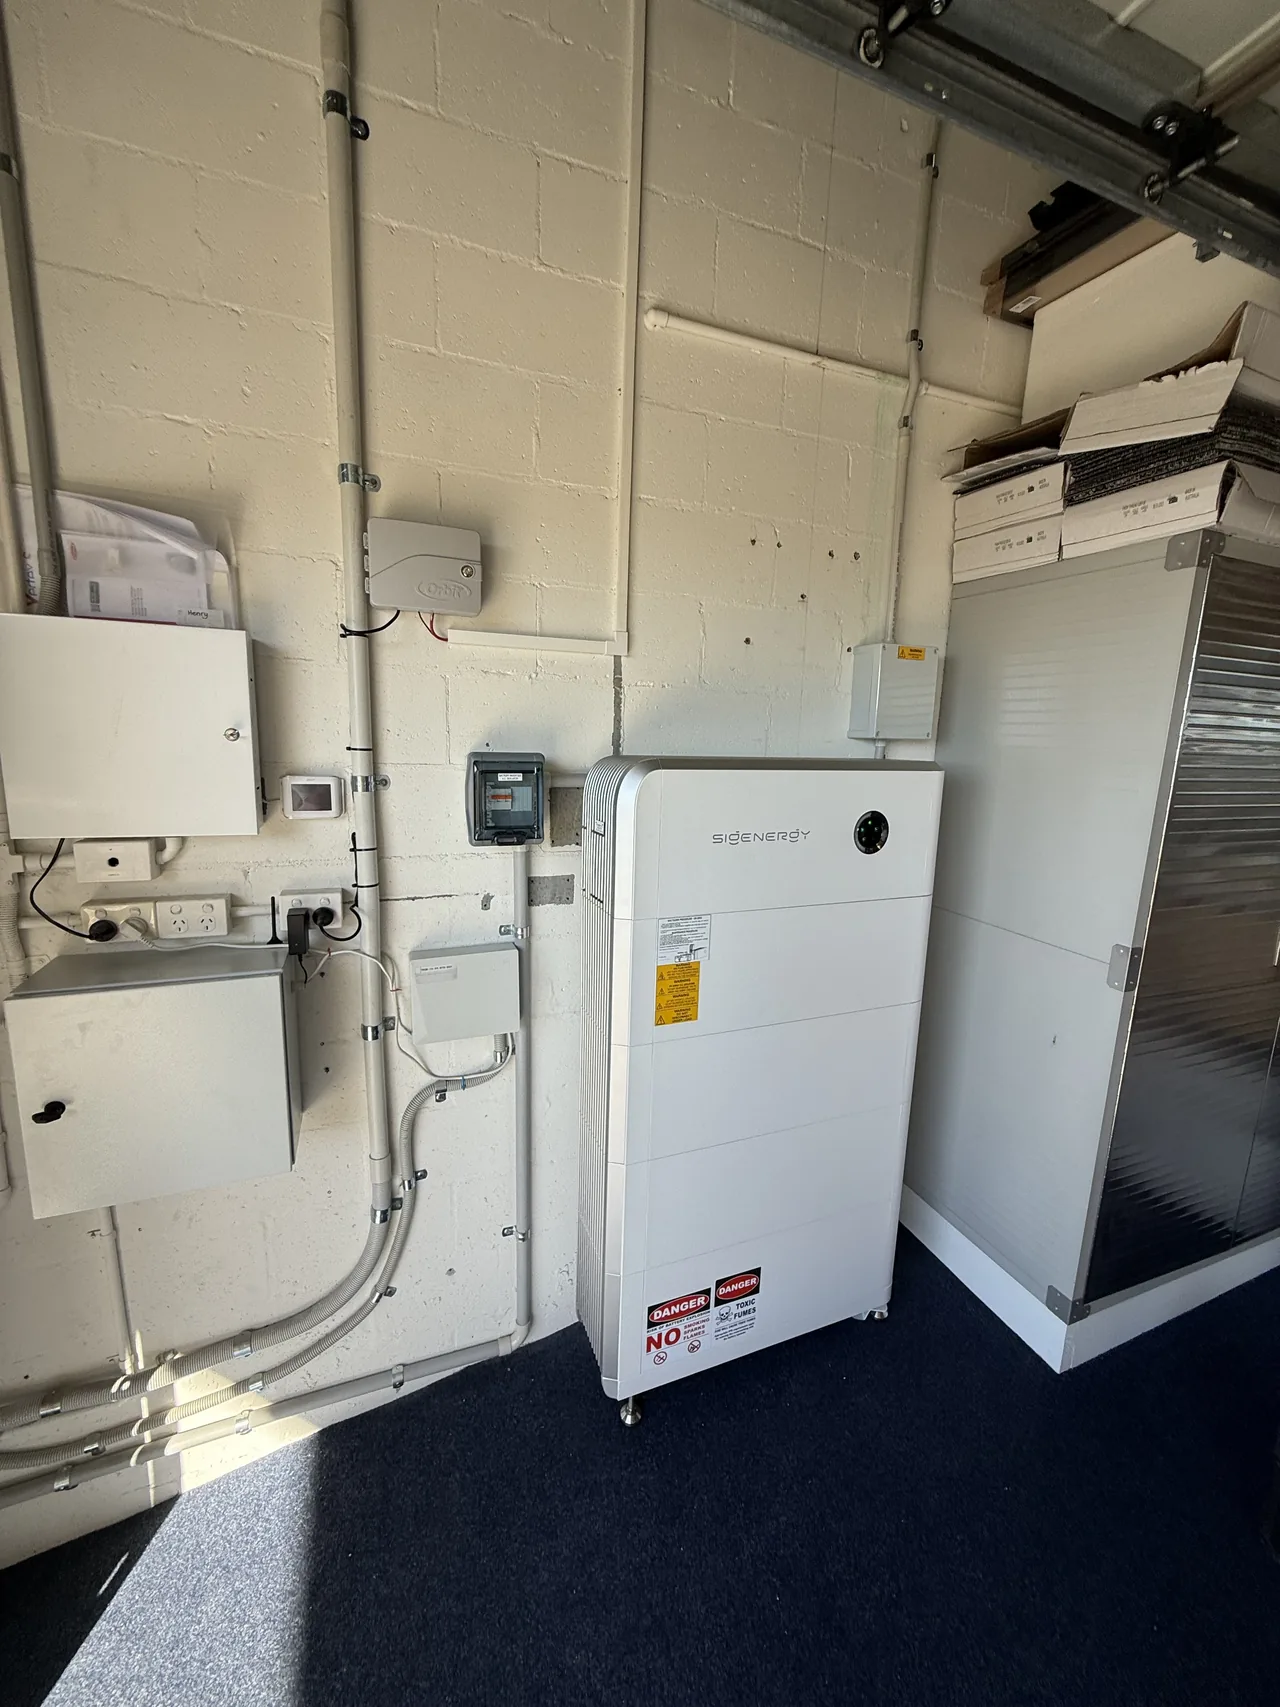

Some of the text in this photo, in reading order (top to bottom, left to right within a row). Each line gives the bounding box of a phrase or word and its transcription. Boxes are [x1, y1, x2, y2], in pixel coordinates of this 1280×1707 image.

[428, 582, 464, 598] Orbit
[187, 609, 209, 620] Henry
[719, 1278, 757, 1296] DANGER
[653, 1296, 706, 1321] DANGER
[736, 1298, 756, 1310] TOXIC
[733, 1307, 757, 1320] FUMES
[665, 1319, 685, 1328] BATTERY
[684, 1318, 710, 1329] SMOKING
[684, 1324, 705, 1335] SPARKS
[646, 1328, 681, 1353] NO
[683, 1330, 705, 1341] FLAMES
